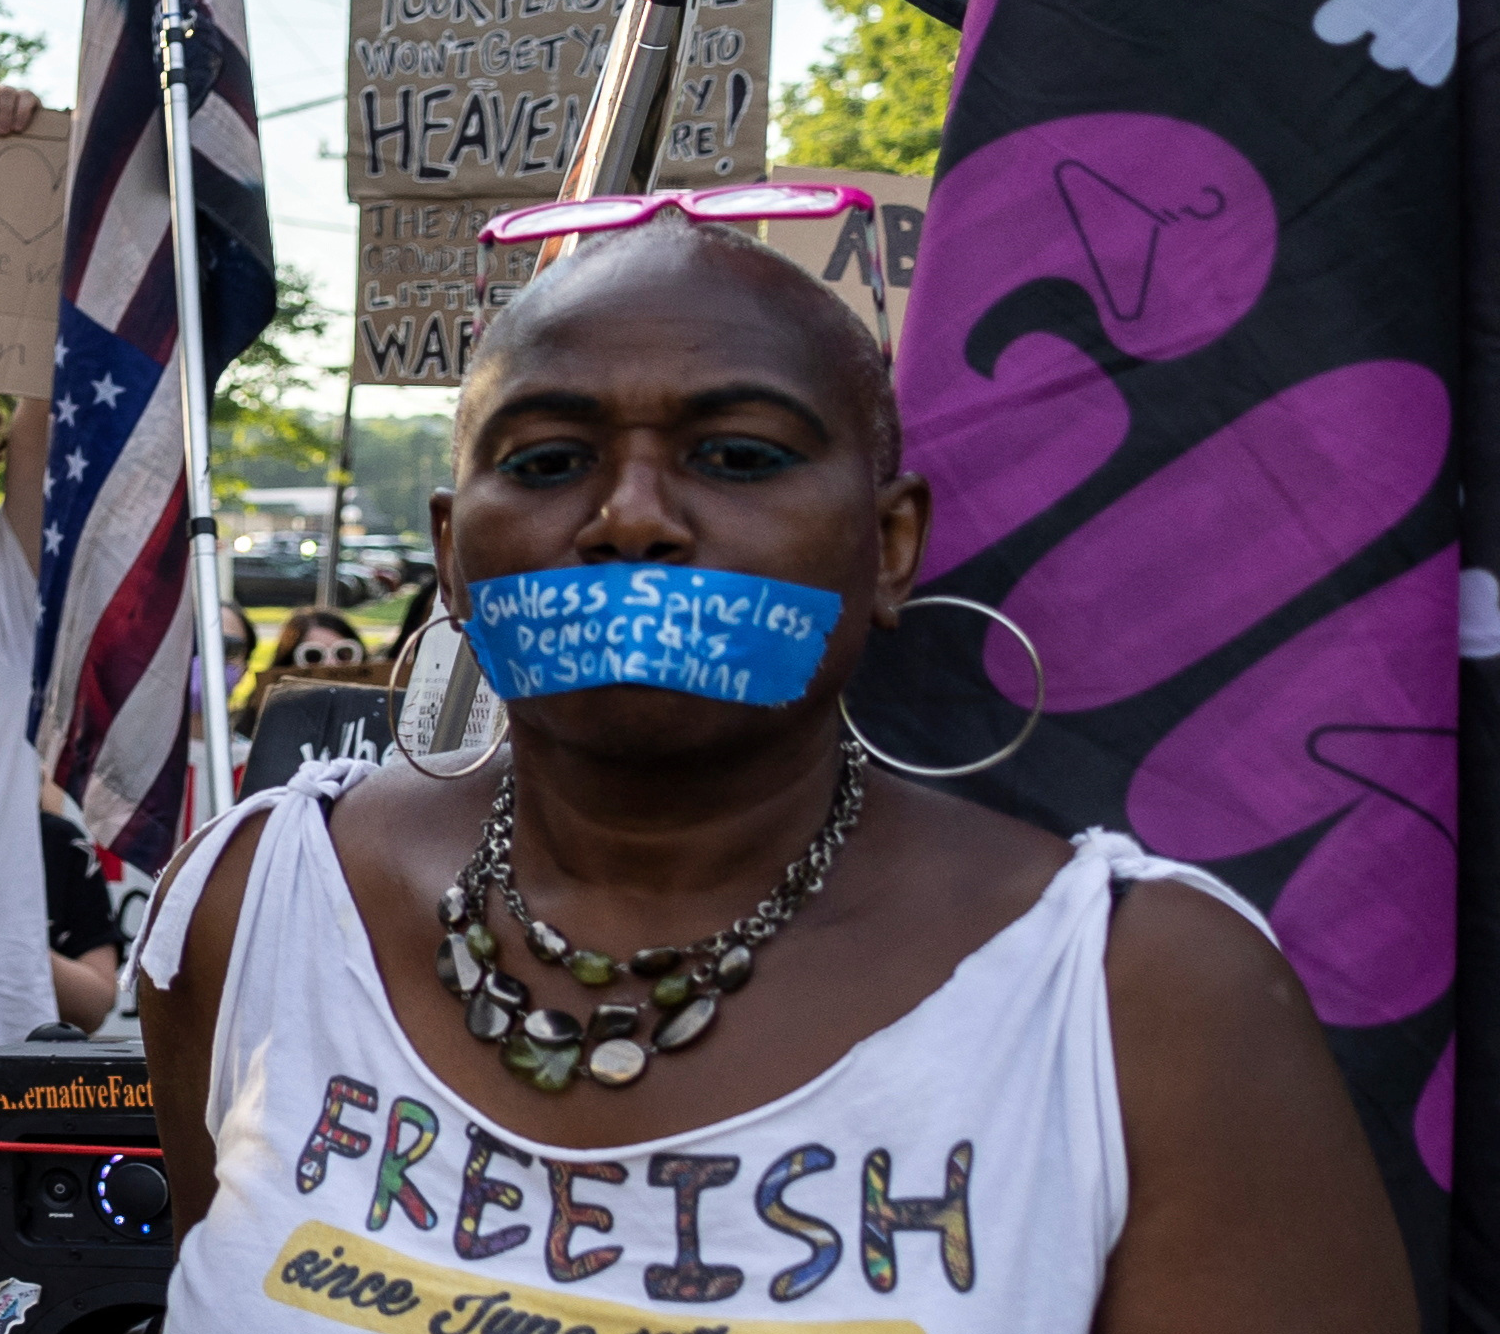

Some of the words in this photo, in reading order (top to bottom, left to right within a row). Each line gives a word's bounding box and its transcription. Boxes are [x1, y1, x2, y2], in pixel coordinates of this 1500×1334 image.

[355, 29, 479, 80] WON'T
[479, 28, 568, 77] GET
[363, 200, 511, 240] THEY'R
[622, 568, 813, 641] Spineless
[295, 1073, 978, 1305] FREEISH
[280, 1245, 421, 1318] since
